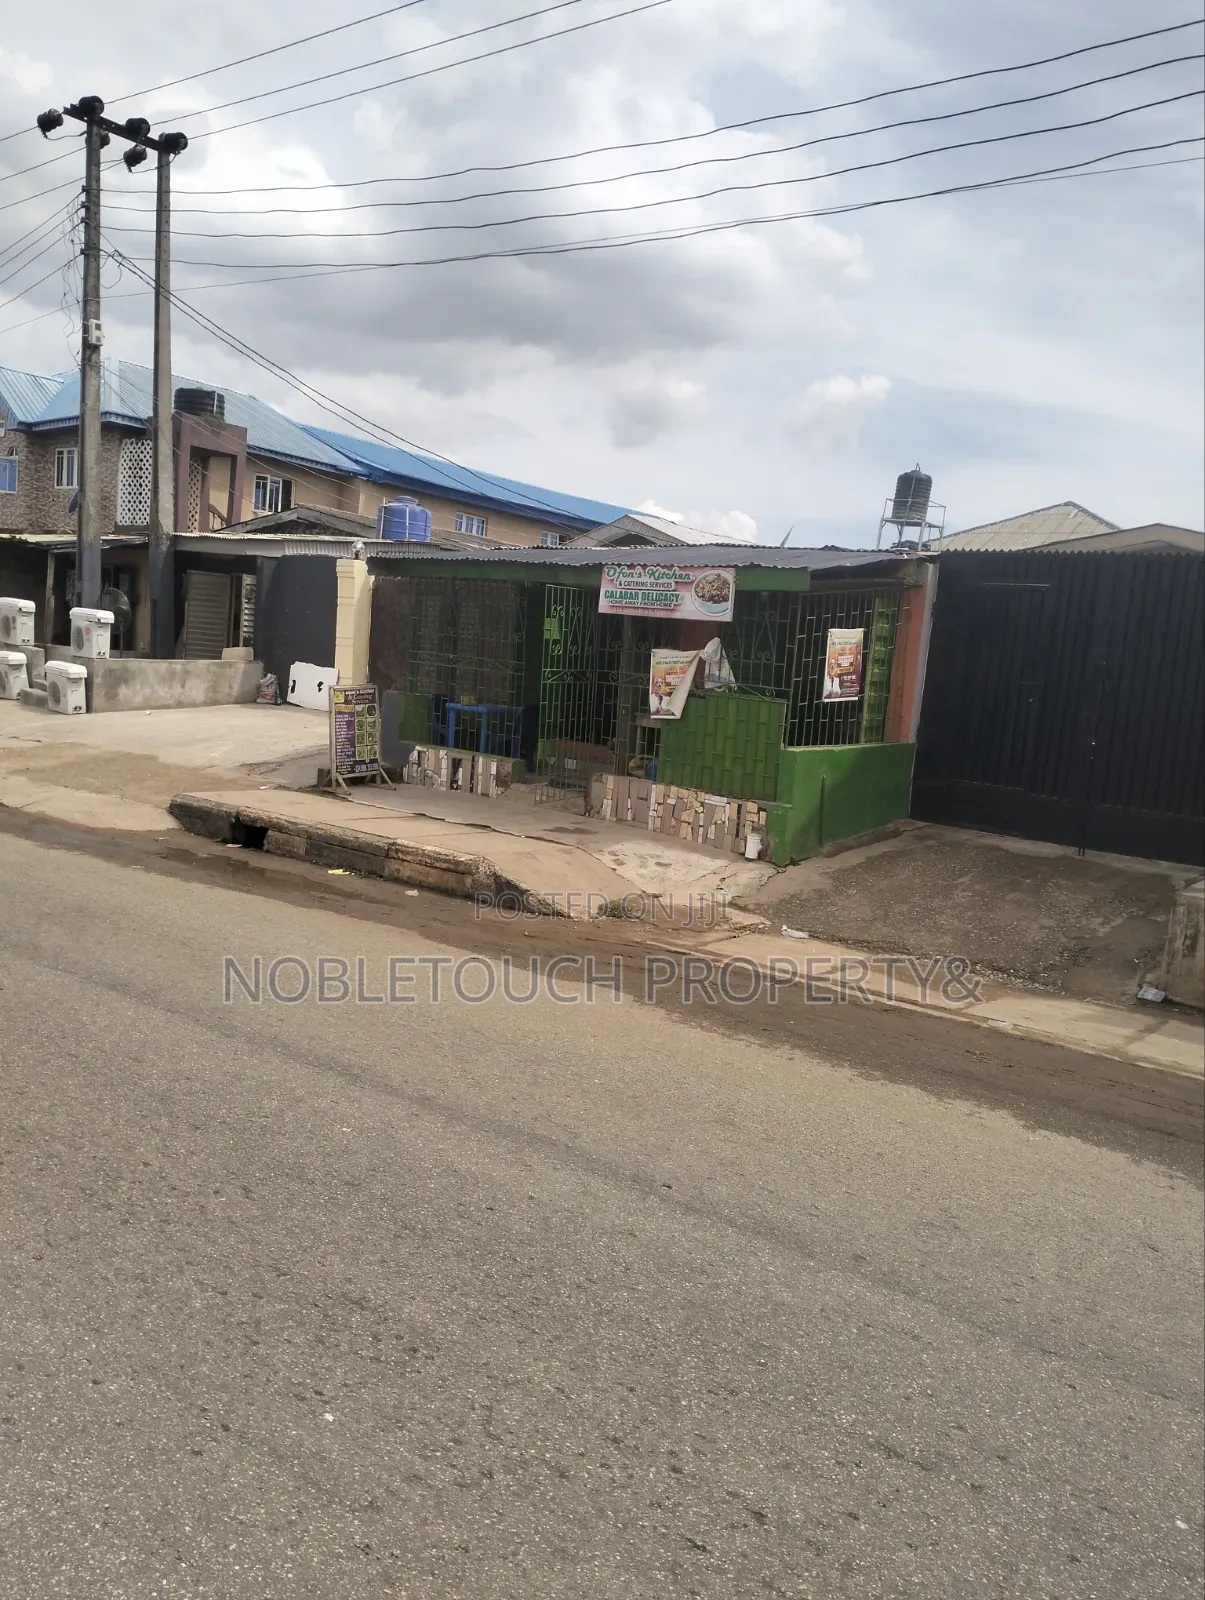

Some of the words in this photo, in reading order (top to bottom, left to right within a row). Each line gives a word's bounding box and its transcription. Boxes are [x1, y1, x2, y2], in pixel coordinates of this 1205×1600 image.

[605, 566, 642, 582] Ofon's
[645, 567, 692, 581] Kitchen
[604, 590, 639, 600] CALABAR
[641, 592, 680, 602] DELICACY
